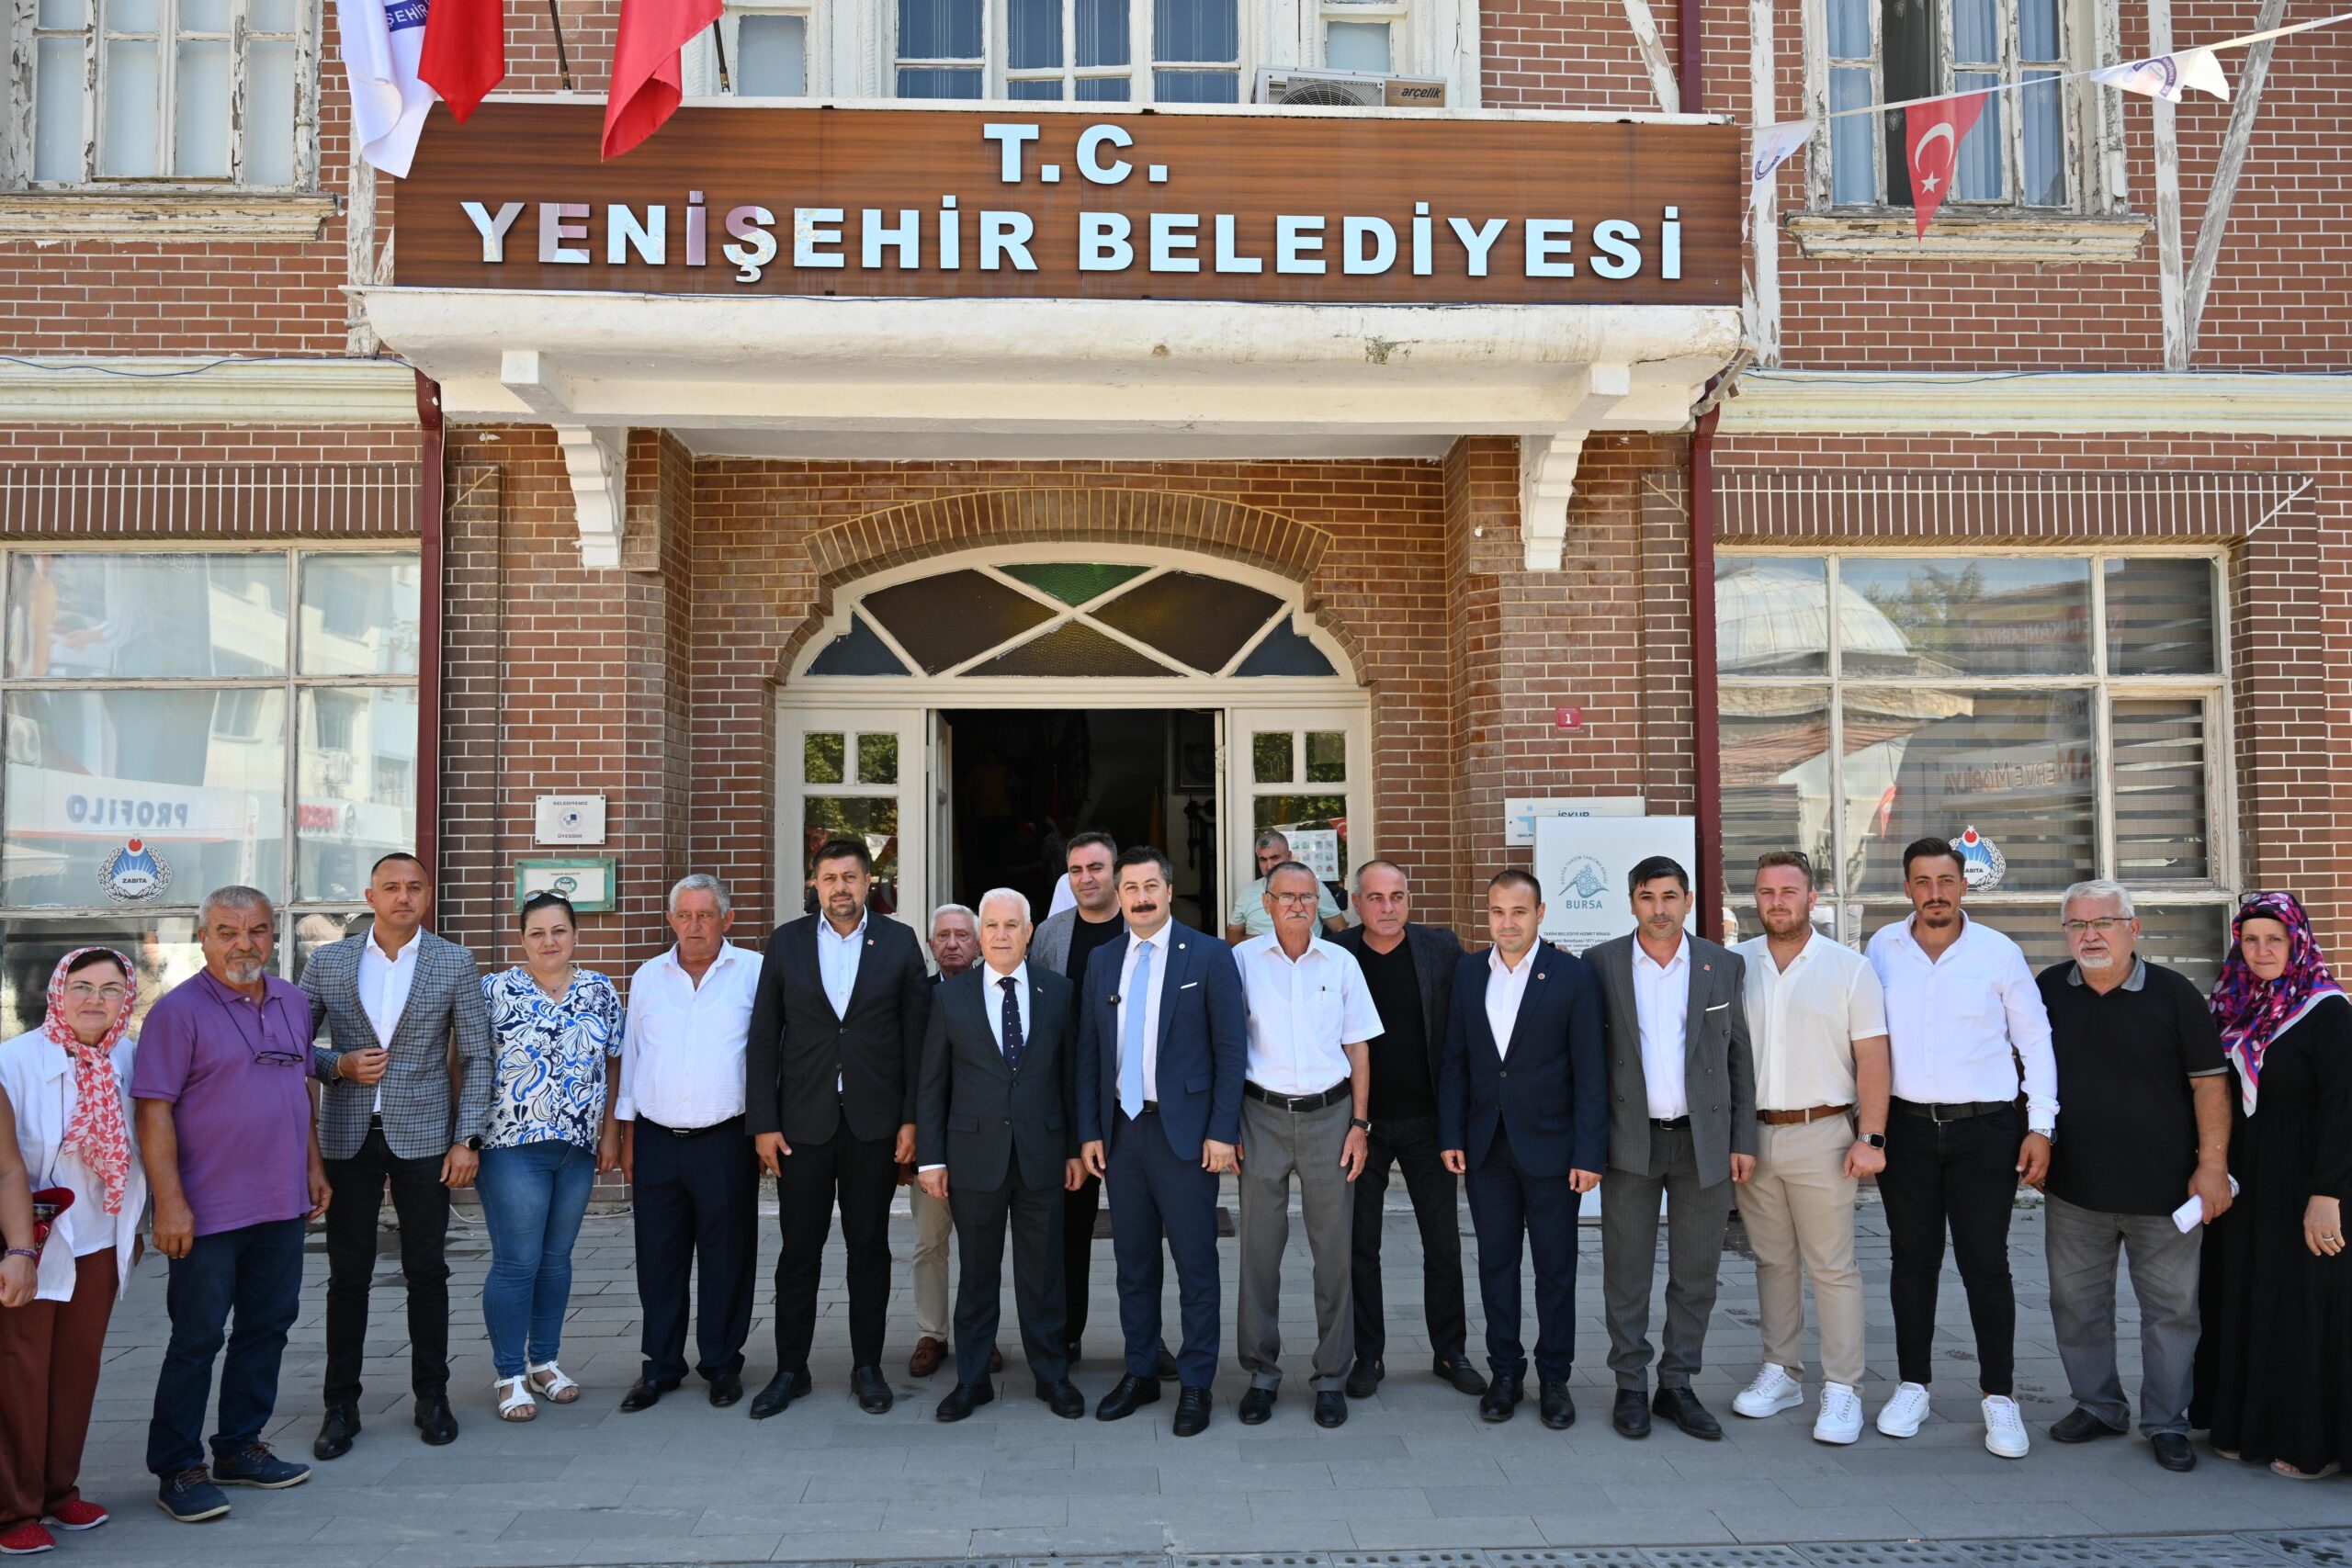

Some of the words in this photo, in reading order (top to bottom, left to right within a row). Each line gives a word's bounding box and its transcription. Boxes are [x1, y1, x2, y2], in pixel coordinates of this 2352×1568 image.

[1401, 87, 1441, 99] arçelik
[983, 122, 1168, 185] T.C.
[460, 190, 1038, 284] YENİŞEHİR
[1078, 201, 1682, 280] BELEDİYESİ
[1565, 713, 1573, 725] 1
[1566, 899, 1603, 909] BURSA
